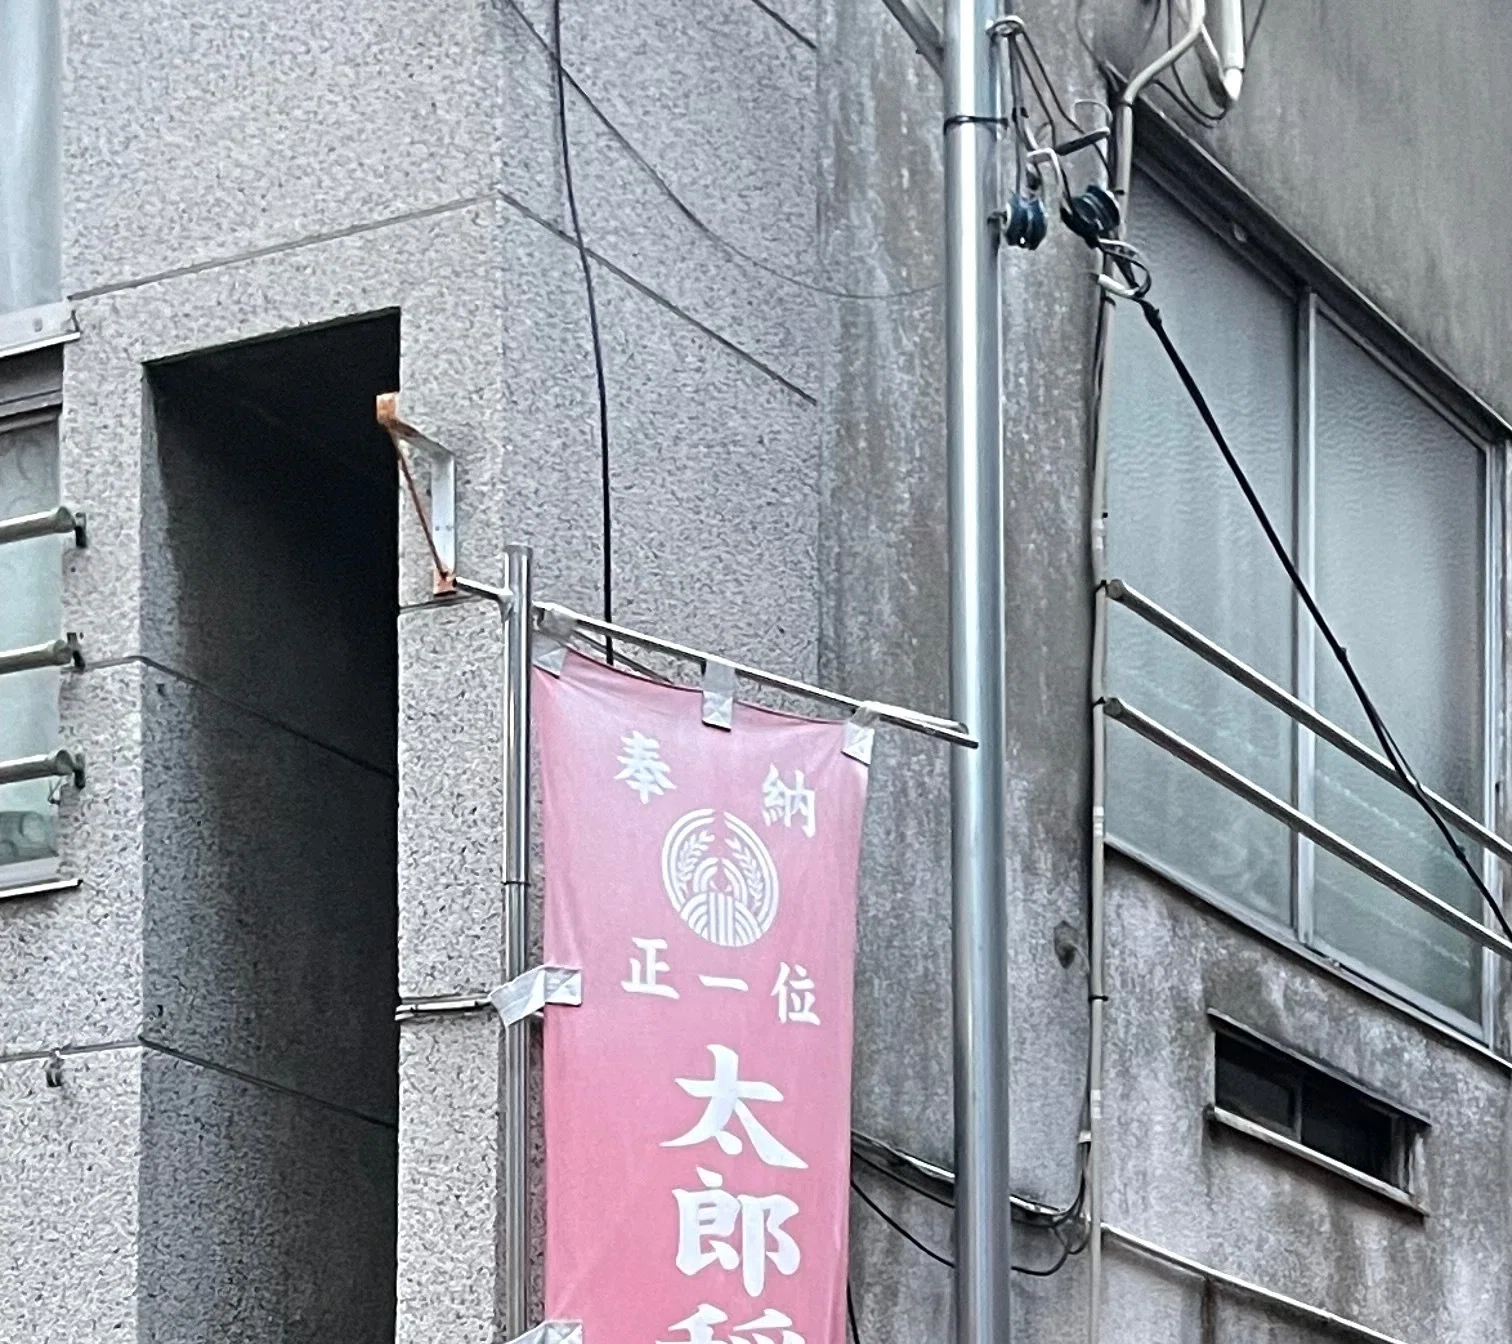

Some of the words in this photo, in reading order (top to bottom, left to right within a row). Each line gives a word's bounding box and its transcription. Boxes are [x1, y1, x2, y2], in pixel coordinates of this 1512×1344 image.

[614, 730, 816, 838] 奉納
[620, 936, 821, 1026] 正一位
